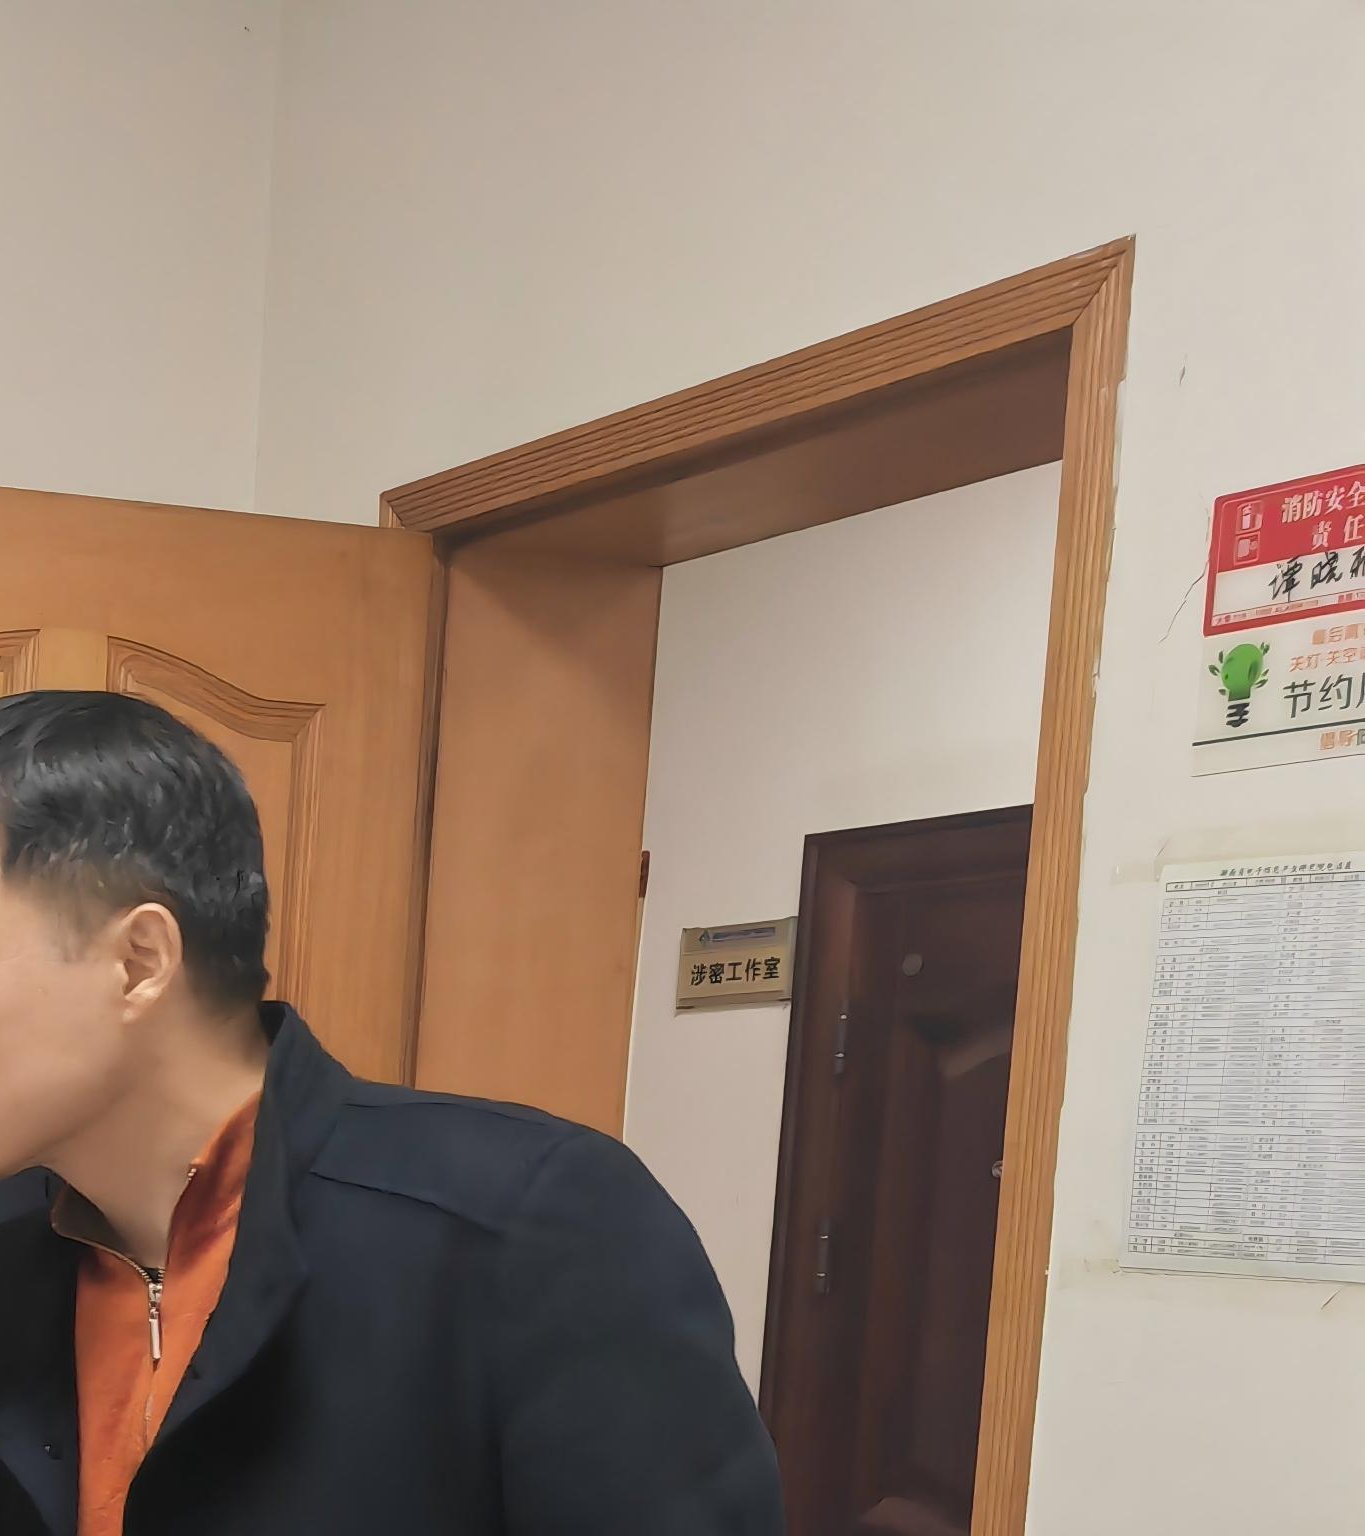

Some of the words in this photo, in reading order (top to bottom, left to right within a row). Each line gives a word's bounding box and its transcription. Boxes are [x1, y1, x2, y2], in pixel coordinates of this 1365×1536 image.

[1282, 672, 1365, 719] 节约
[690, 956, 781, 986] 涉密工作室
